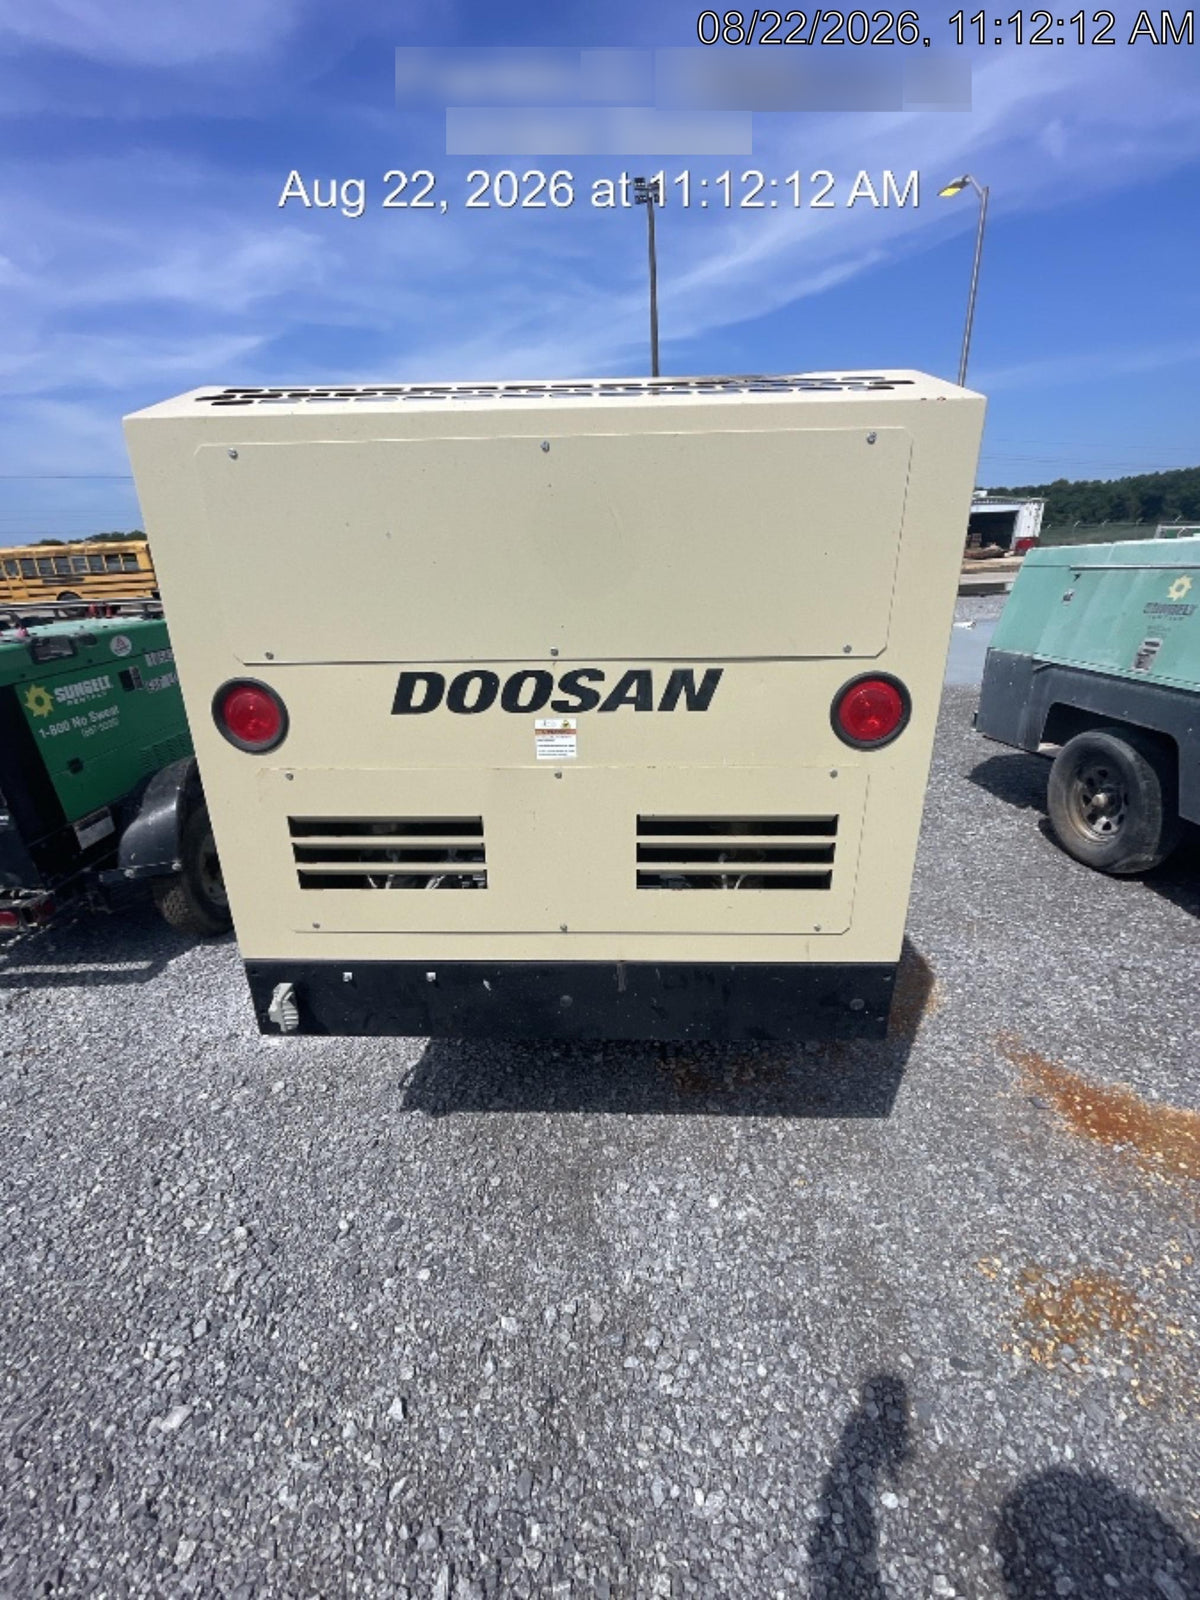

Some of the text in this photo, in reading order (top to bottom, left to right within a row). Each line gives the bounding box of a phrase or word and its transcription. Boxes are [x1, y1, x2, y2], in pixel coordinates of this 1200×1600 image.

[390, 668, 724, 715] DOOSAN
[38, 720, 70, 738] 1-800
[70, 716, 88, 728] No
